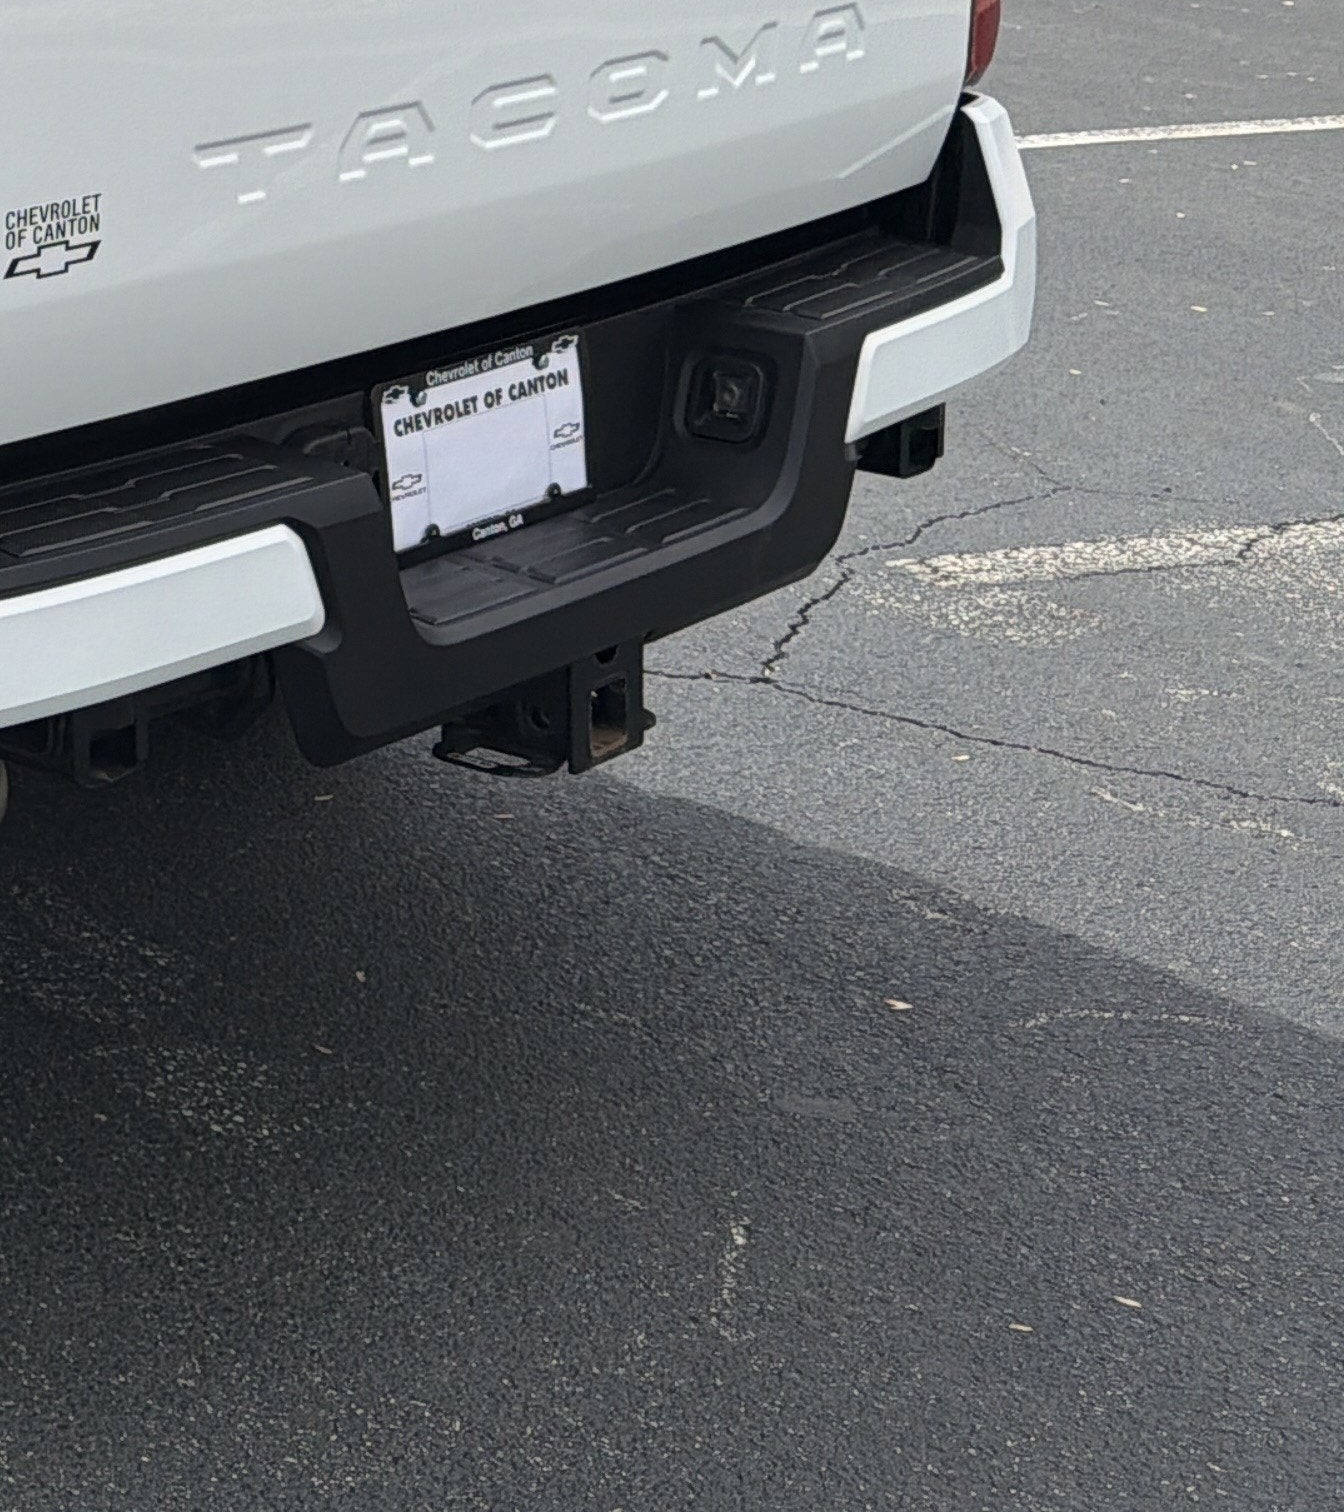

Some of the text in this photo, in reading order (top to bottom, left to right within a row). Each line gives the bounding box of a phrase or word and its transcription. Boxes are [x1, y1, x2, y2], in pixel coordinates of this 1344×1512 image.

[192, 1, 866, 205] TACOMA
[5, 193, 102, 231] CHEVROLET
[5, 213, 100, 250] OF CANTON
[426, 345, 534, 387] Chevrolet of Canton
[393, 369, 569, 437] CHEVROLET OF CANTON
[472, 513, 524, 541] Canton, GA
